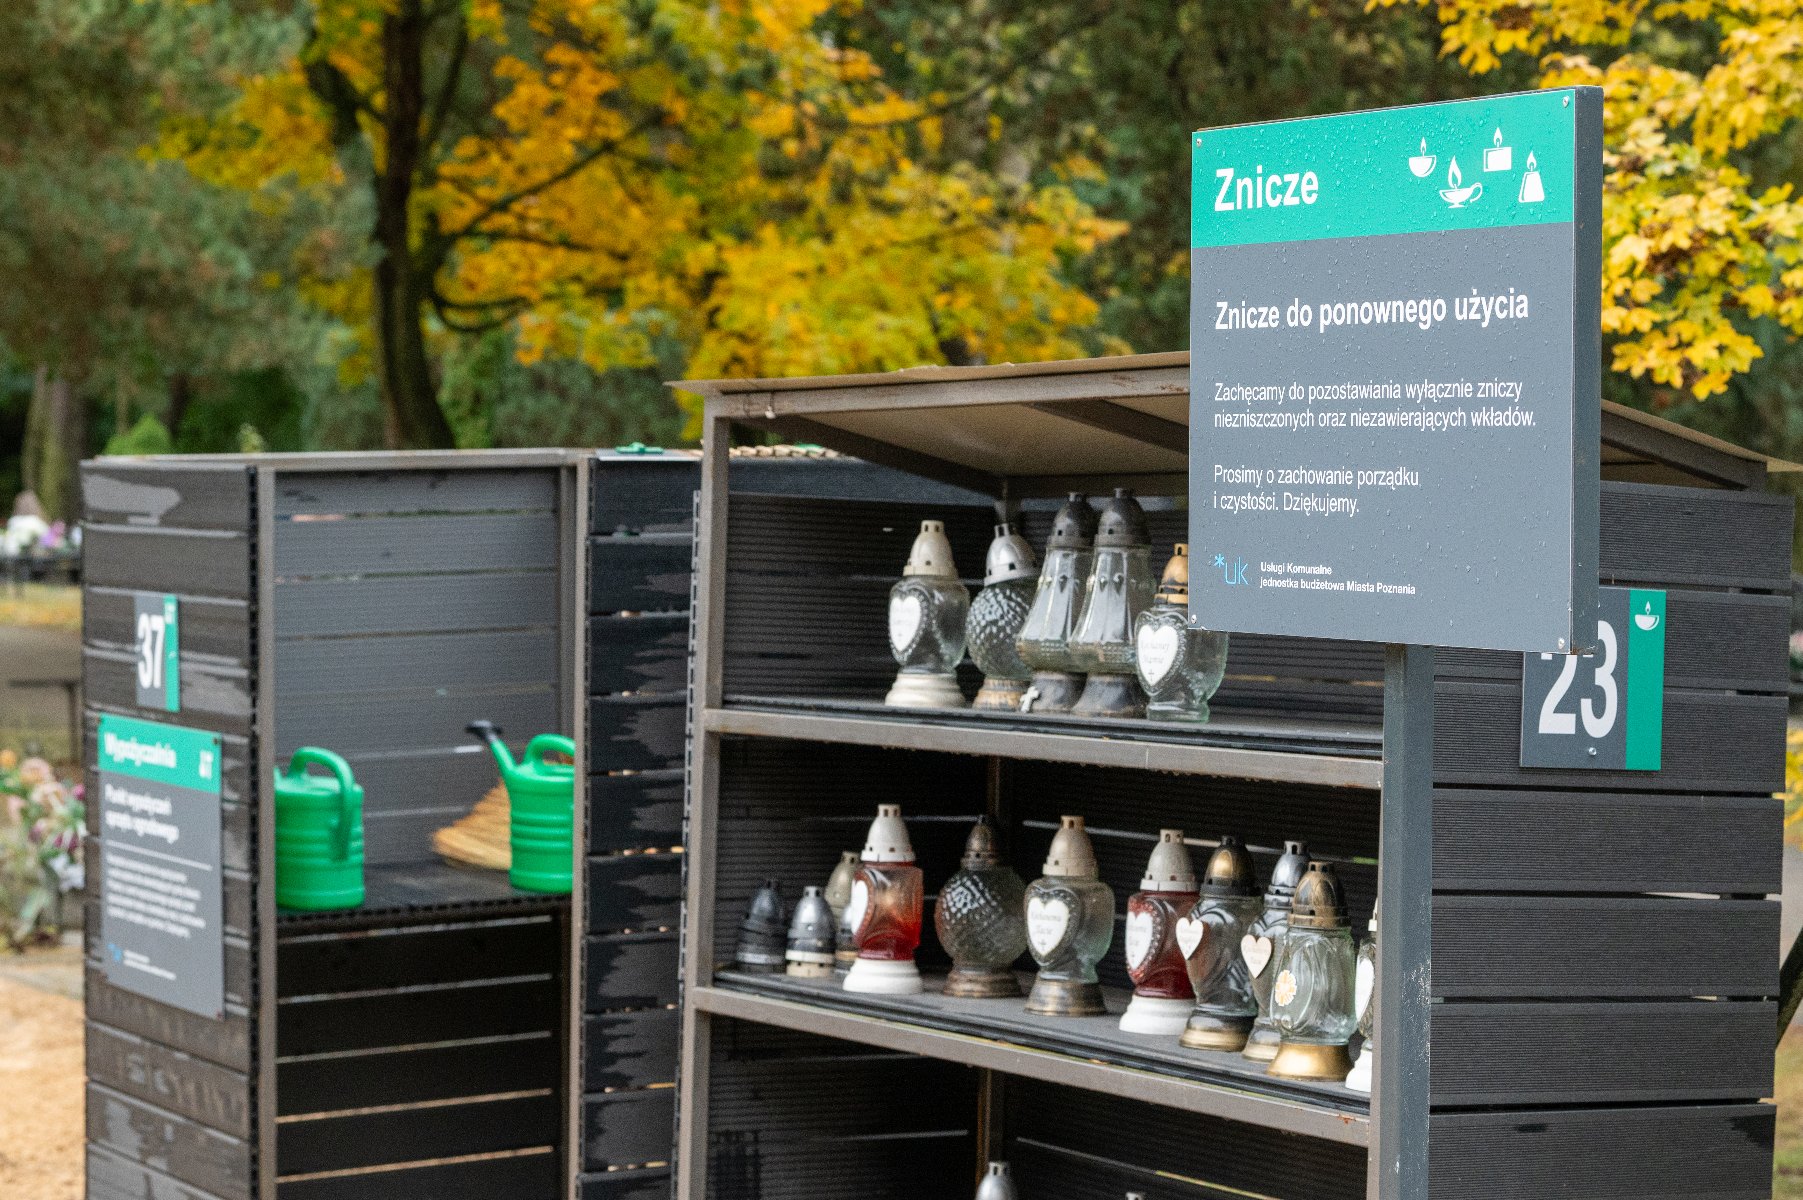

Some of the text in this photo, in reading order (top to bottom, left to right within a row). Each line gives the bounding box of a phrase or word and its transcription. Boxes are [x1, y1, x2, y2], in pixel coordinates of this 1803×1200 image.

[1214, 164, 1319, 212] Znicze
[1215, 287, 1529, 334] Znicze do ponownego użycia
[1214, 377, 1523, 406] Zachęcamy do pozostawiania wyłącznie zniczy
[1214, 405, 1536, 432] niezniszczonych oraz niezawierających wkładów.
[1214, 464, 1419, 491] Prosimy o zachowanie porządku
[1220, 491, 1279, 515] czystości.
[1283, 491, 1360, 518] Dziękujemy.
[1260, 561, 1333, 576] Usługi Komunalne
[1259, 576, 1416, 595] jednostka budżetowa Miasta Poznania
[137, 613, 165, 689] 37
[1538, 620, 1618, 738] 23
